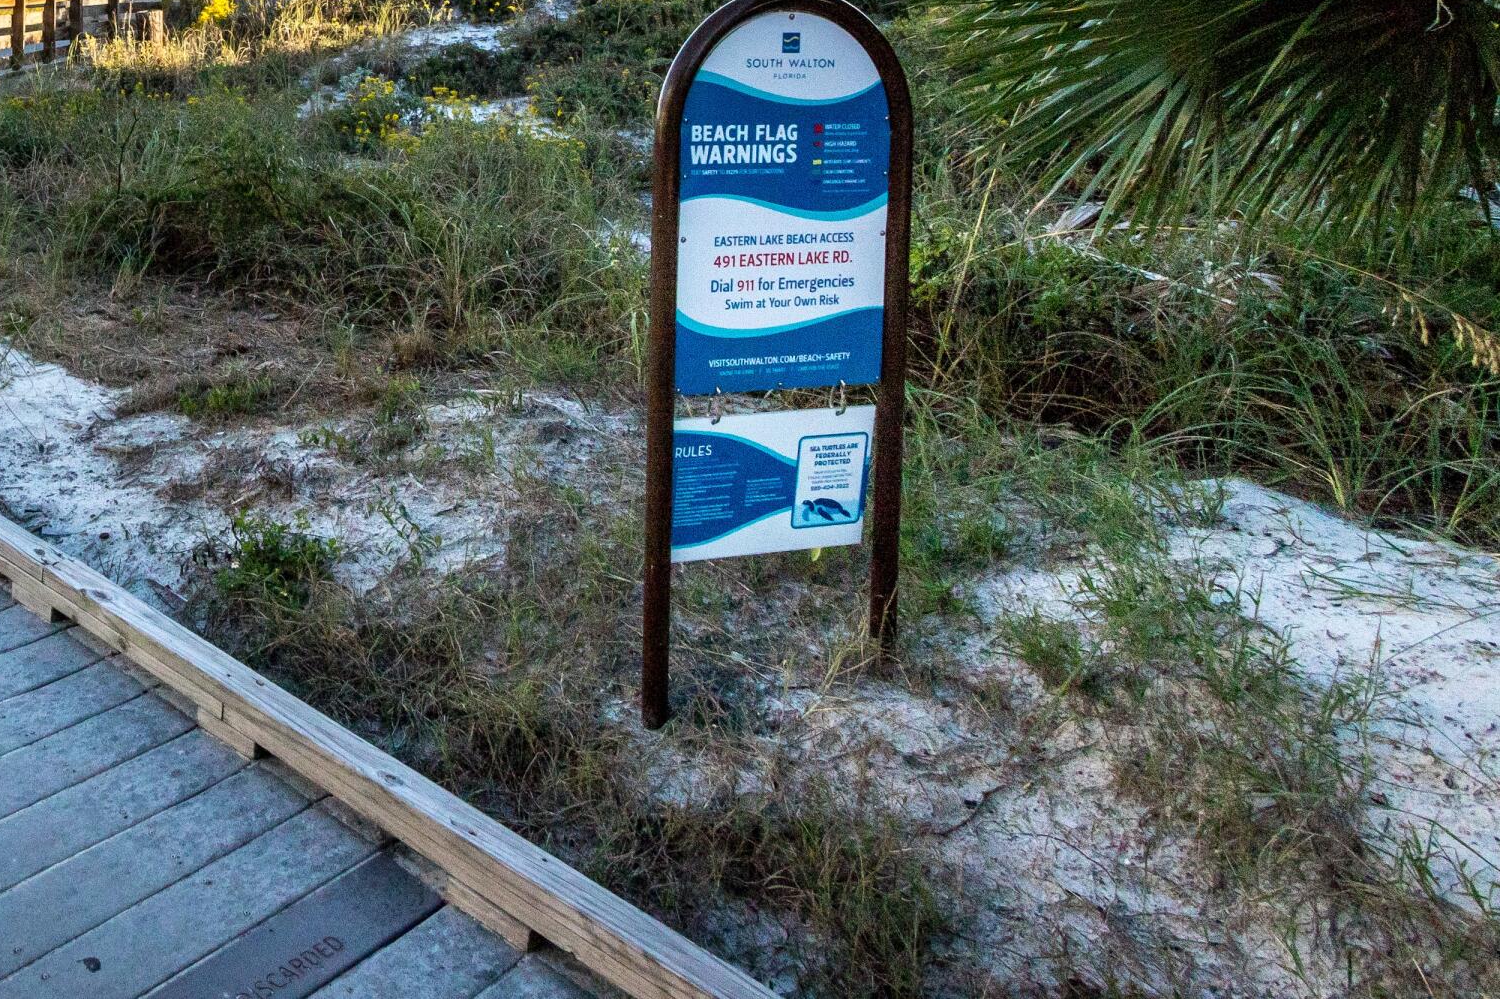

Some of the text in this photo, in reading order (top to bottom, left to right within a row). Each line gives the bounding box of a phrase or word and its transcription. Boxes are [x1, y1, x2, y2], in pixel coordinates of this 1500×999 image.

[746, 58, 835, 68] SOUTH WALTON
[691, 124, 798, 142] BEACH FLAG
[690, 143, 798, 165] WARNINGS
[714, 232, 854, 247] EASTERN LAKE BEACH ACCESS
[713, 250, 853, 268] 491 EASTERN LAKE RD.
[710, 274, 854, 293] Dial 911 for Emergencies
[725, 294, 840, 310] Swim at Your Own Risk
[708, 352, 850, 368] VISITSOUTHWALTON.COM/BEACH-SAFETY
[675, 445, 712, 458] RULES
[815, 451, 852, 459] FEDERALLY
[814, 458, 851, 466] PROTECTED
